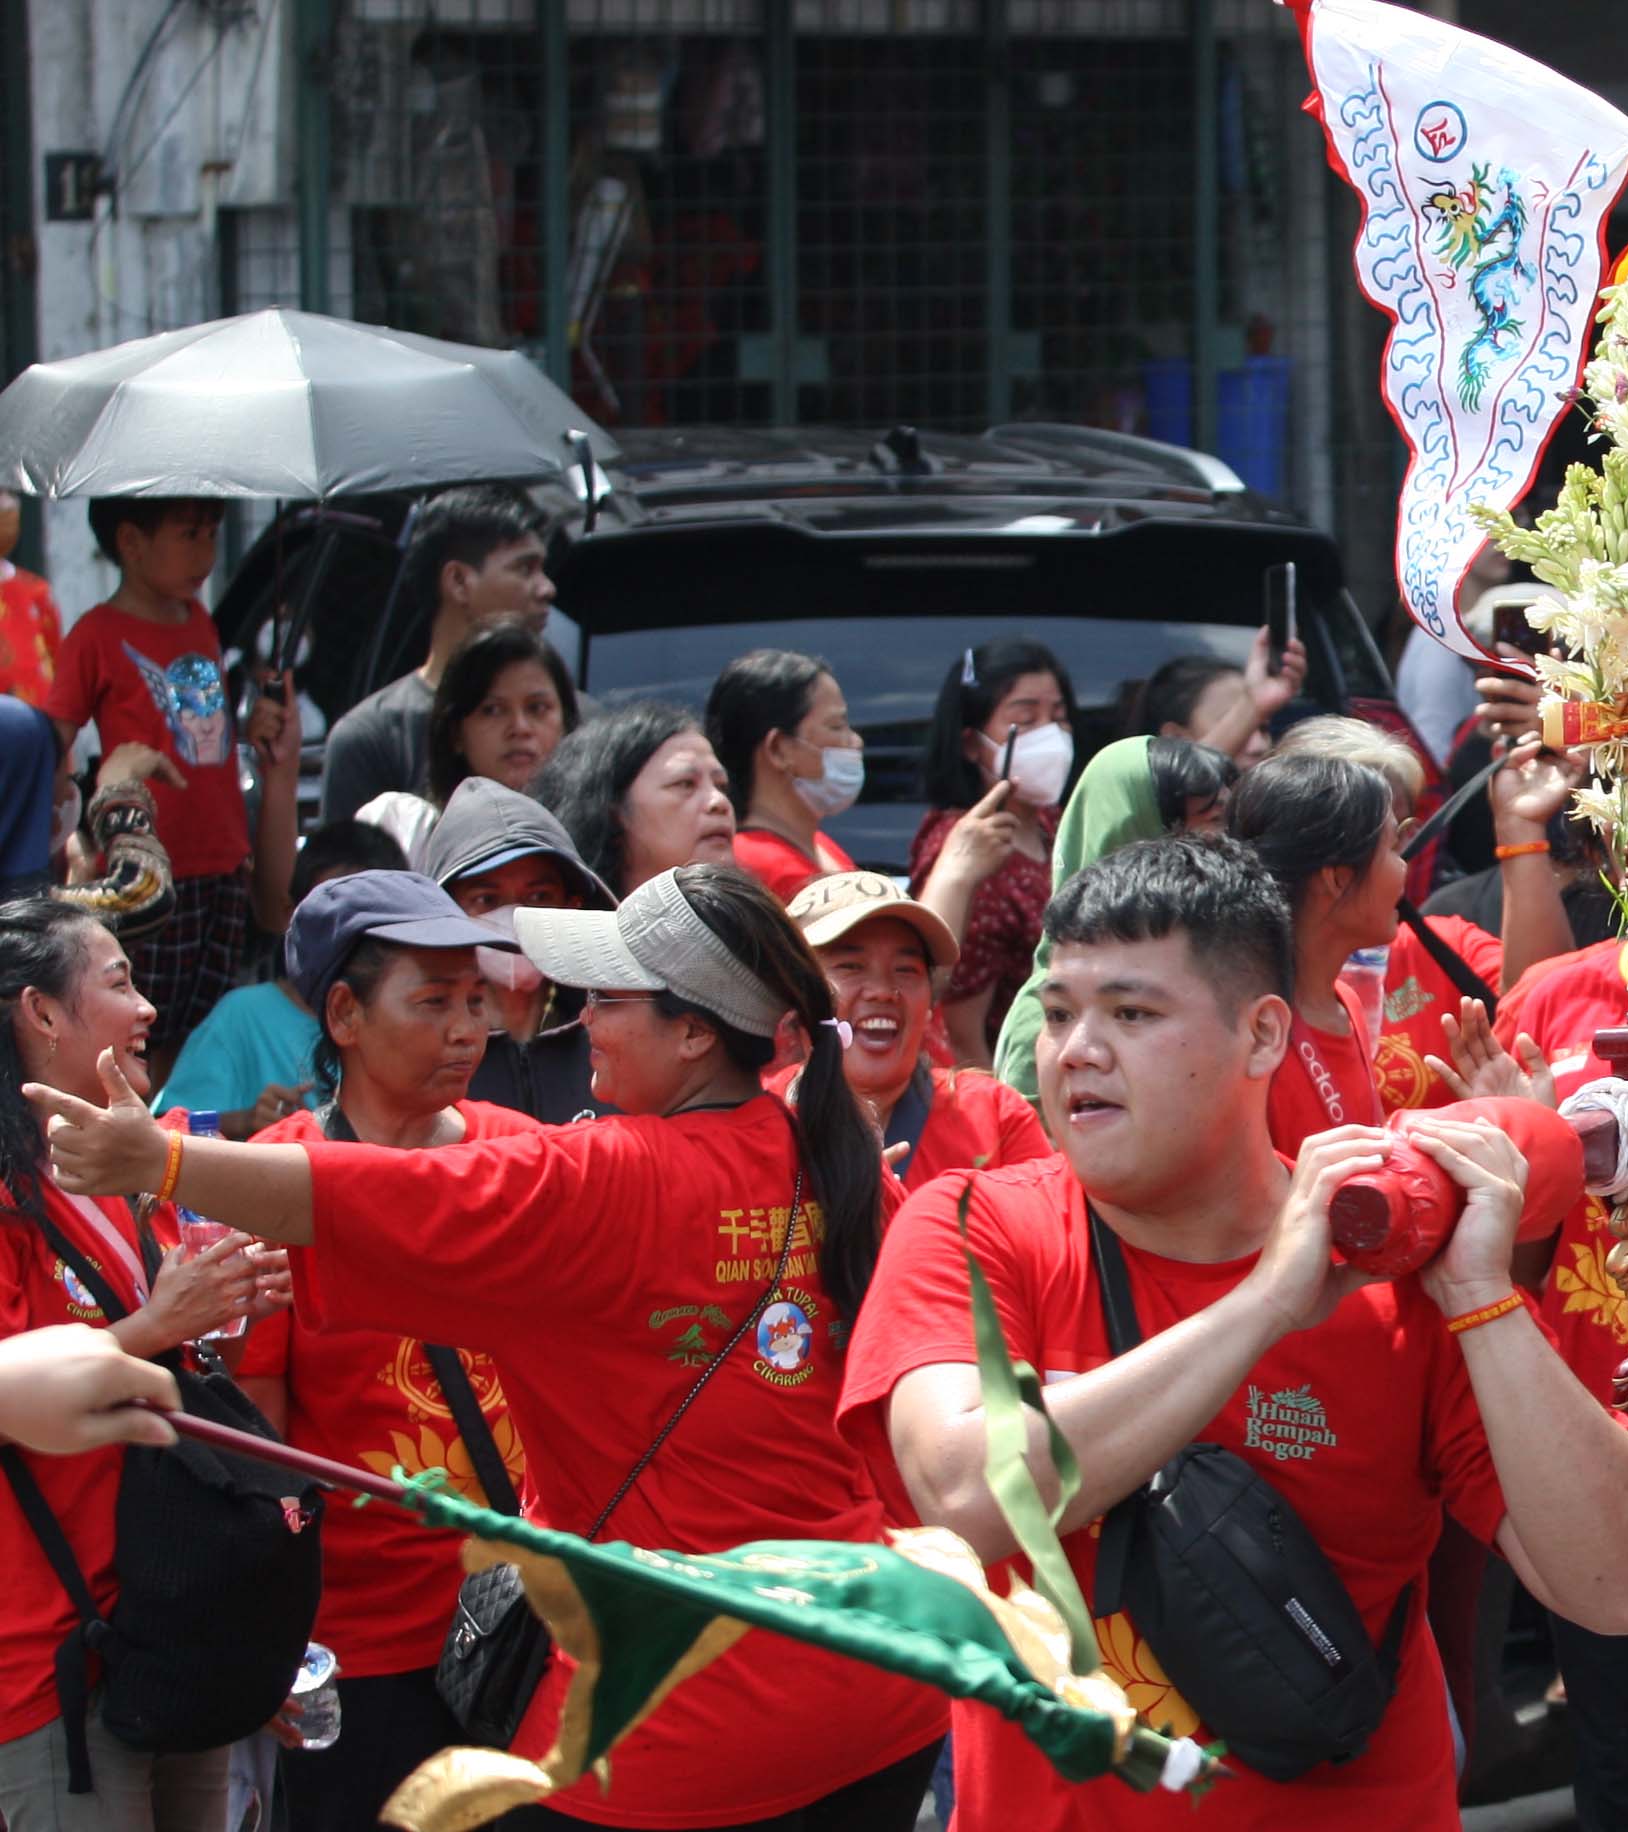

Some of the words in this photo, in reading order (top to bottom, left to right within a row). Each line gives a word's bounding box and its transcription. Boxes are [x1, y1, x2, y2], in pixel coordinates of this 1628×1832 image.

[715, 1259, 750, 1283] QIAN
[752, 1358, 815, 1387] CIKARANG
[1243, 1431, 1316, 1461] Bogor
[1246, 1416, 1337, 1447] Rempah
